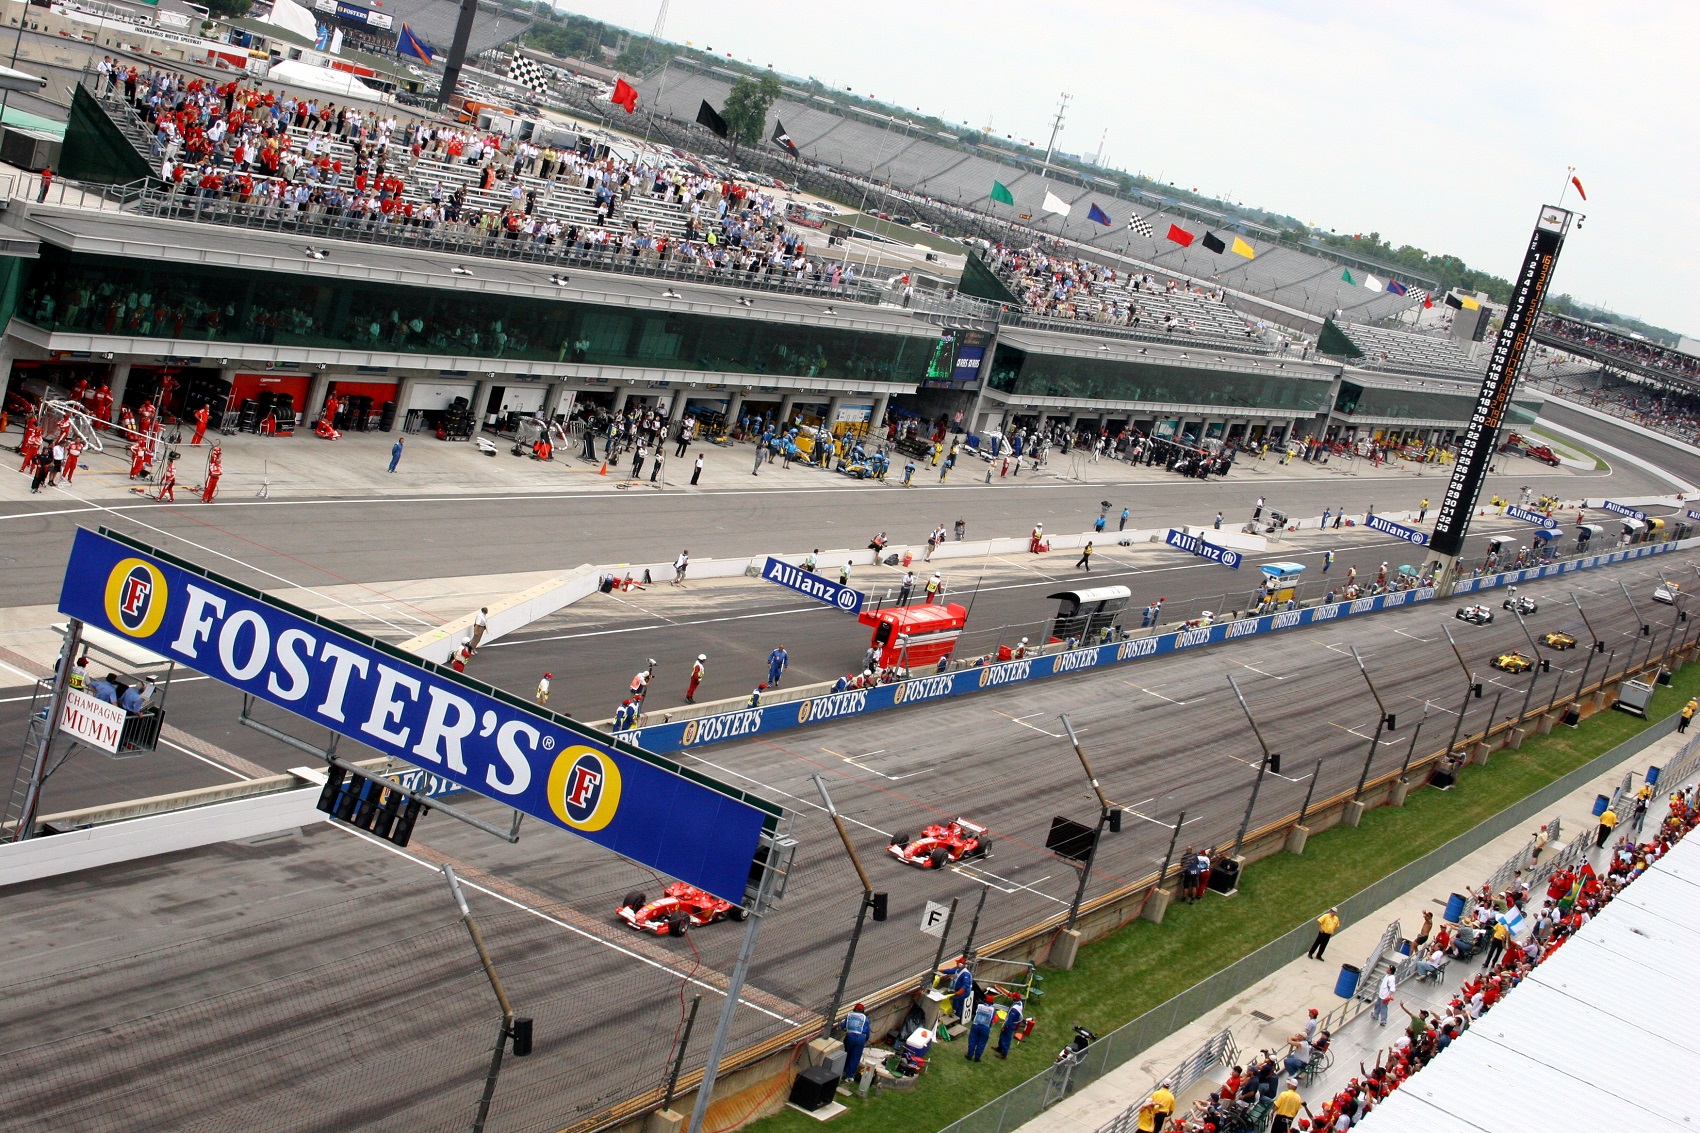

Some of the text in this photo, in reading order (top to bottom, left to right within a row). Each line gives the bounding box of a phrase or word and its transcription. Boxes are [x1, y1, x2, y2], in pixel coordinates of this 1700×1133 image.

[134, 26, 203, 46] INDIANAPOLIS MOTOR SPEEDWAY
[1535, 282, 1543, 290] 6
[1502, 330, 1513, 338] 10
[1500, 338, 1511, 347] 11
[1497, 347, 1508, 355] 12
[1494, 355, 1505, 364] 13
[1491, 364, 1502, 372] 14
[1488, 372, 1499, 380] 15
[1486, 381, 1496, 389] 16
[1482, 389, 1494, 397] 17
[1480, 398, 1490, 406] 18
[1477, 406, 1488, 414] 19
[1472, 414, 1497, 427] 20 20
[1469, 422, 1482, 432] 21
[1467, 431, 1479, 440] 22
[1464, 439, 1477, 448] 23
[1461, 448, 1474, 457] 24
[1458, 456, 1471, 465] 25
[1456, 465, 1468, 474] 26
[1453, 473, 1465, 482] 27
[1450, 482, 1463, 491] 28
[1447, 490, 1460, 499] 29
[1444, 498, 1457, 507] 30
[1442, 507, 1454, 516] 31
[1605, 502, 1635, 518] Allianz
[1439, 515, 1452, 524] 32
[1509, 507, 1543, 525] Allianz
[1370, 517, 1411, 540] Allianz
[1436, 523, 1449, 532] 33
[1170, 532, 1221, 560] Allinz
[769, 562, 836, 601] Allianz
[1316, 604, 1340, 621] FOSTER'S
[1275, 610, 1301, 629] FOSTER'S
[1231, 618, 1260, 638] FOSTER'S
[1180, 626, 1211, 648] FOSTER'S
[1124, 637, 1159, 659] FOSTER'S
[1059, 648, 1099, 672] FOSTER'S
[986, 660, 1032, 686] FOSTER'S
[904, 675, 955, 702] FOSTER'S
[67, 692, 123, 724] CHAMPAGNE
[808, 689, 868, 721] FOSTER'S
[62, 706, 118, 747] MUMM
[697, 709, 763, 744] FOSTER'S
[927, 910, 942, 926] F
